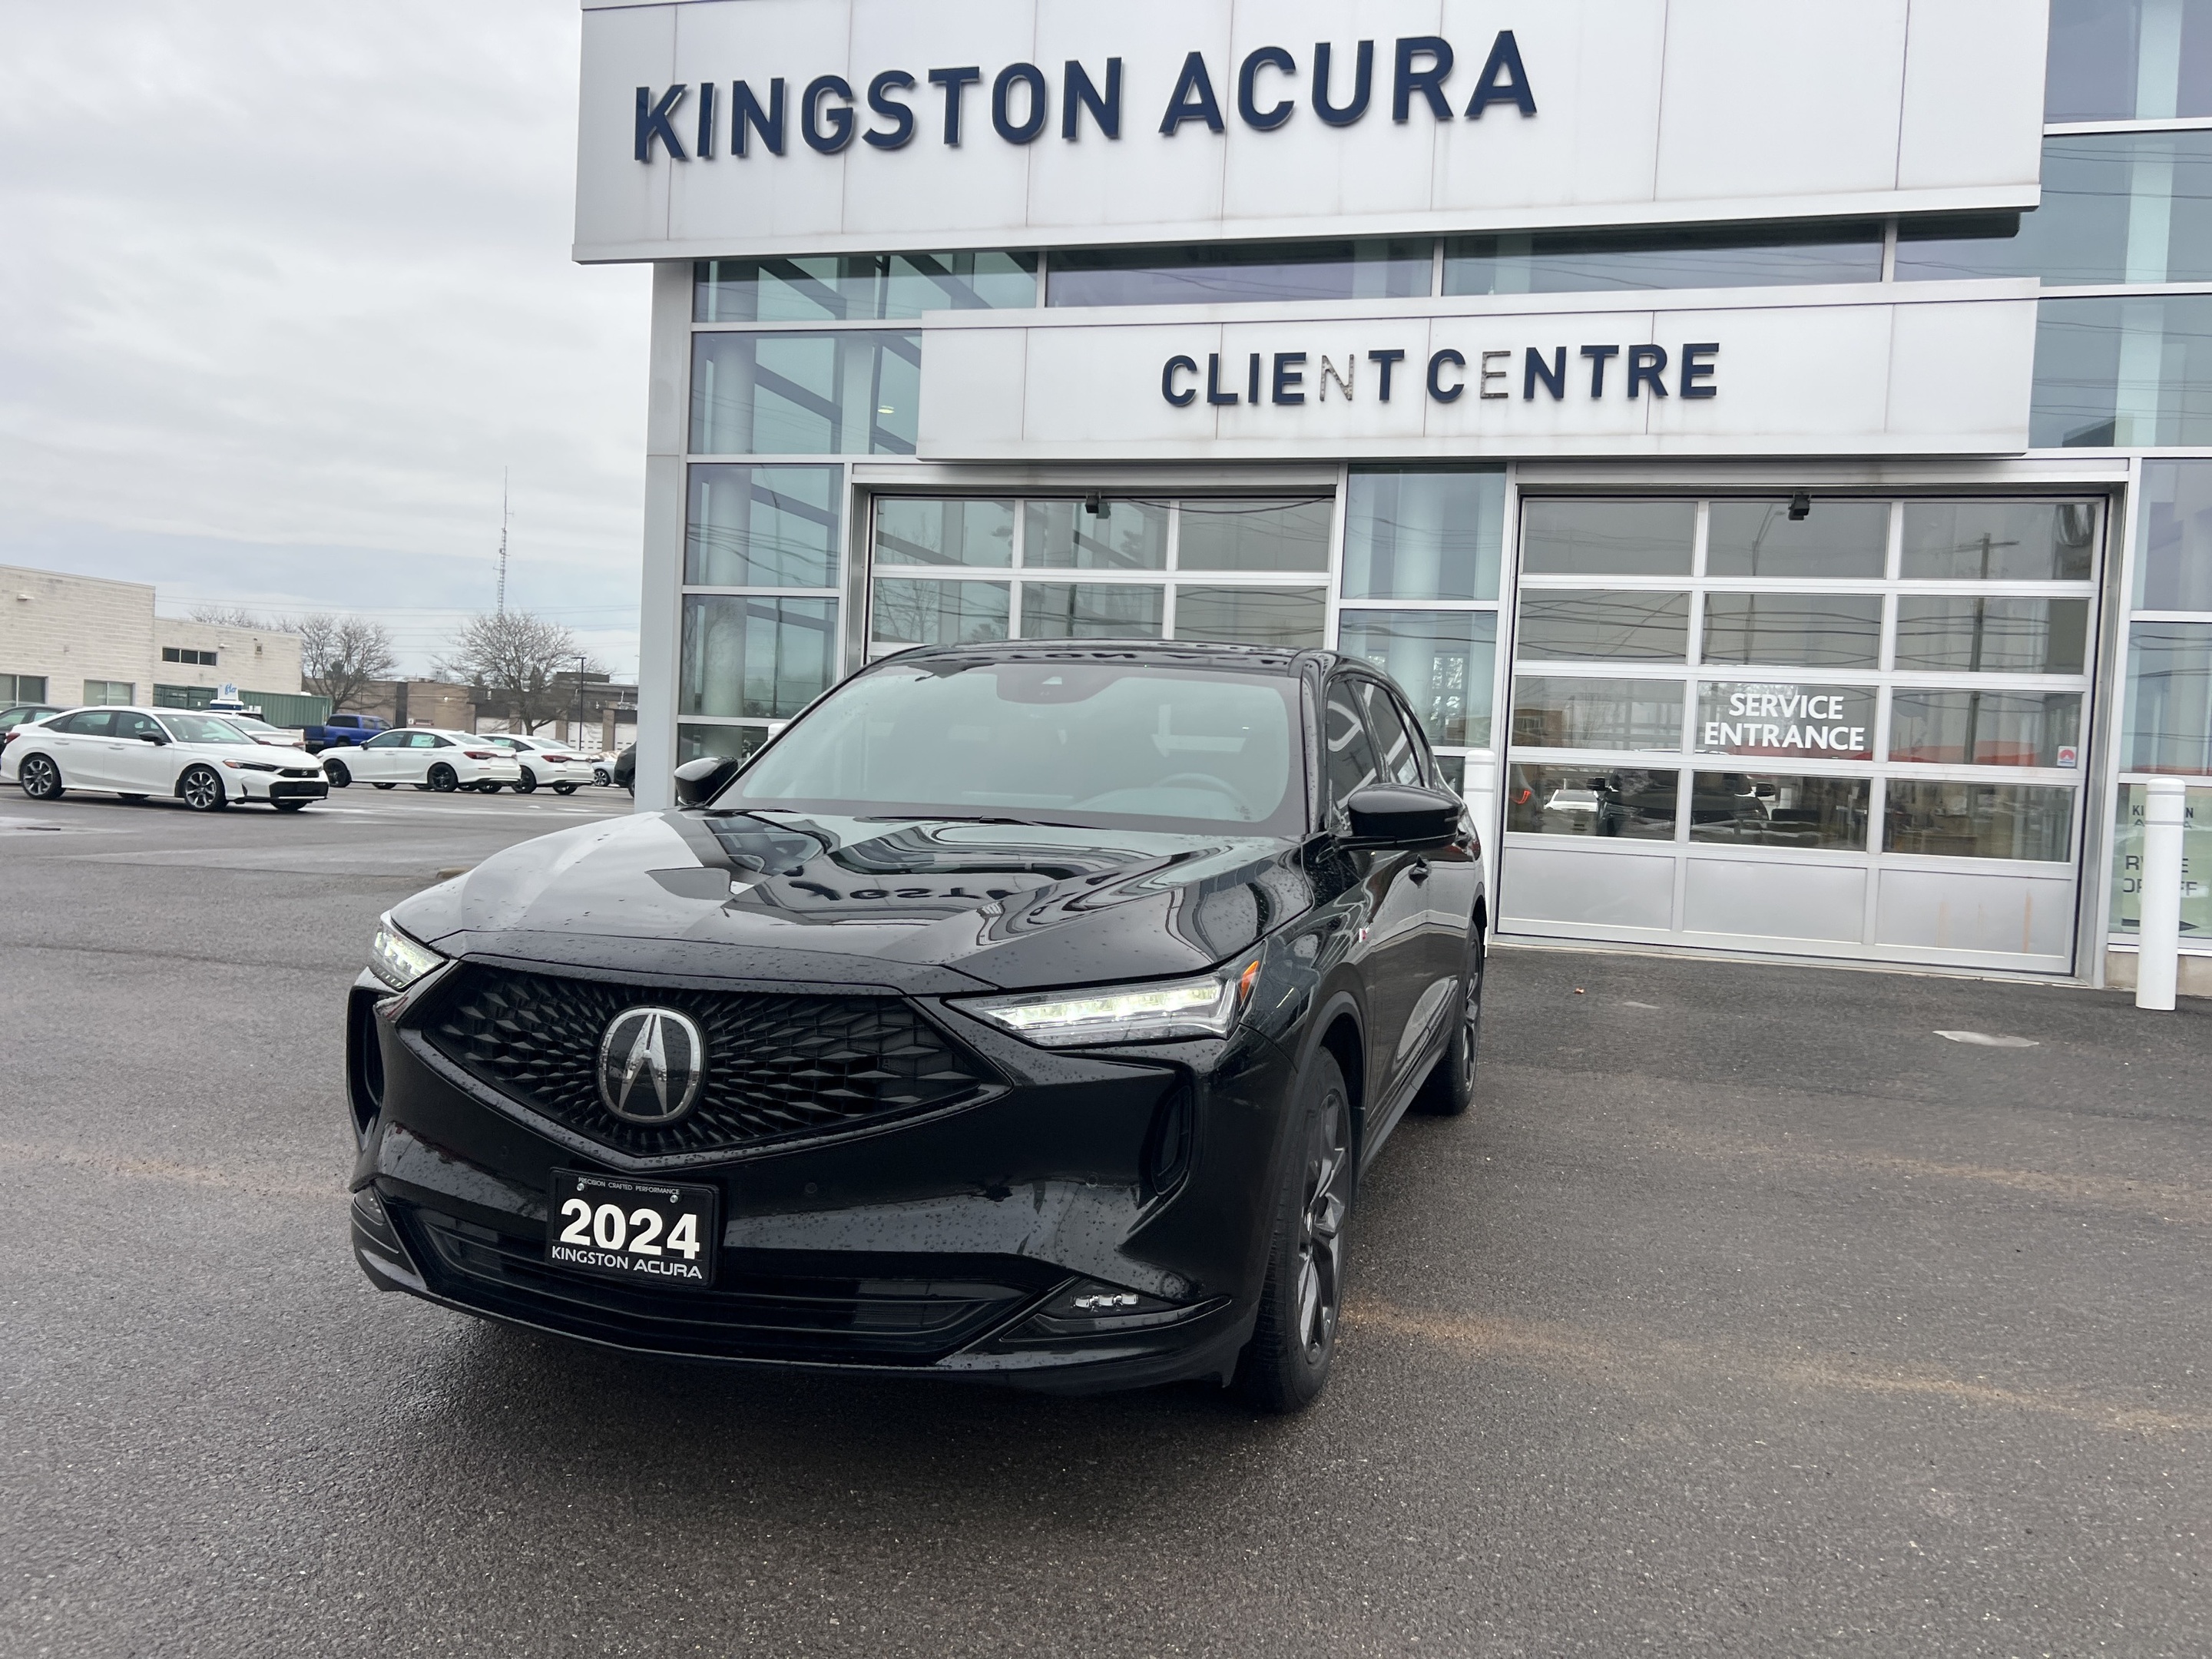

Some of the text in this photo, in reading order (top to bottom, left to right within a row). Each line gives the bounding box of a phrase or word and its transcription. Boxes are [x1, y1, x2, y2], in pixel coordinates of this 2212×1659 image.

[634, 30, 1538, 163] KINGSTON ACURA
[1161, 343, 1720, 407] CLIENT CENTRE
[1729, 692, 1844, 720] SERVICE
[1704, 721, 1865, 751] ENTRANCE
[578, 1177, 680, 1195] PRECISION CRAFTED PERFORMANCE
[560, 1198, 700, 1260] 2024
[551, 1245, 703, 1280] KINGSTON ACURA
